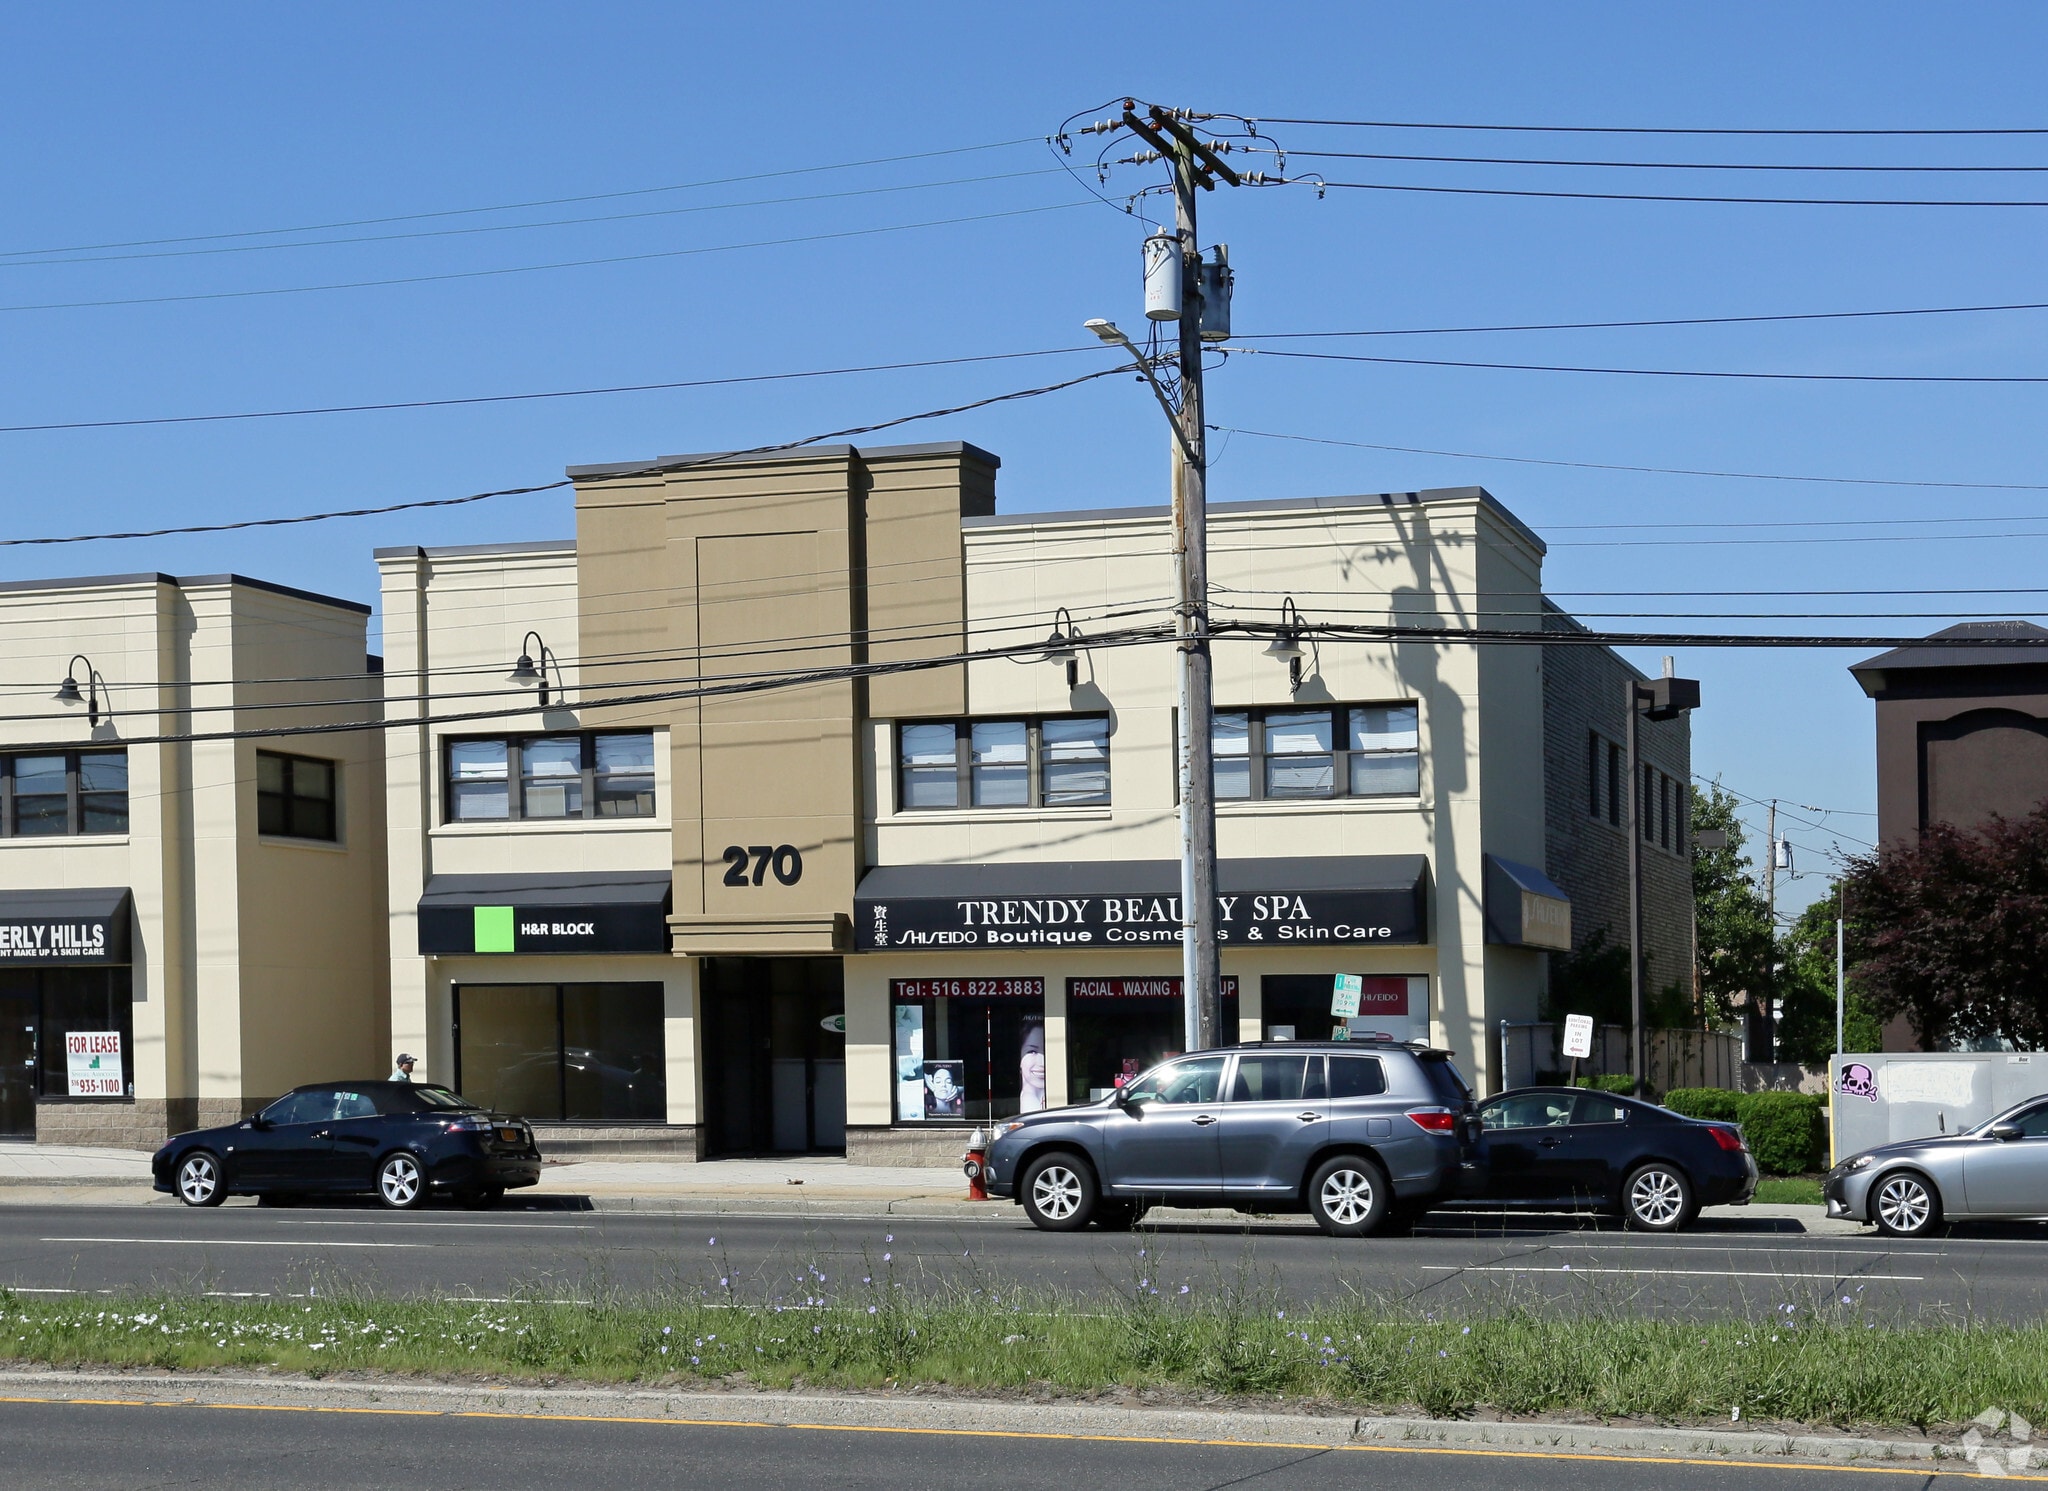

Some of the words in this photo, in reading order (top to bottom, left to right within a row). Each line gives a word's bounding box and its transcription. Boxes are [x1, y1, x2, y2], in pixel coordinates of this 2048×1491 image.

[722, 844, 803, 887] 270
[957, 899, 1091, 925] TRENDY
[1102, 897, 1239, 923] BEAUY
[1253, 895, 1312, 920] SPA
[0, 925, 46, 949] ERLY
[50, 924, 105, 948] HILLS
[521, 923, 549, 935] H&R
[551, 923, 595, 935] BLOCK
[895, 929, 978, 945] SHISEIDO
[987, 929, 1093, 945] Boutique
[1106, 928, 1229, 941] Cosmes
[1247, 926, 1264, 940] &
[13, 949, 37, 957] MAKE
[38, 948, 50, 956] UP
[52, 948, 58, 956] &
[60, 948, 81, 956] SKIN
[82, 948, 105, 956] CARE
[896, 982, 926, 996] Tel:
[931, 981, 1043, 996] 516.822.3883
[1073, 981, 1115, 996] FACIAL
[1361, 993, 1399, 1002] HISEIDO
[68, 1036, 87, 1053] FOR
[90, 1036, 118, 1053] LEASE
[80, 1079, 119, 1093] 935-1100
